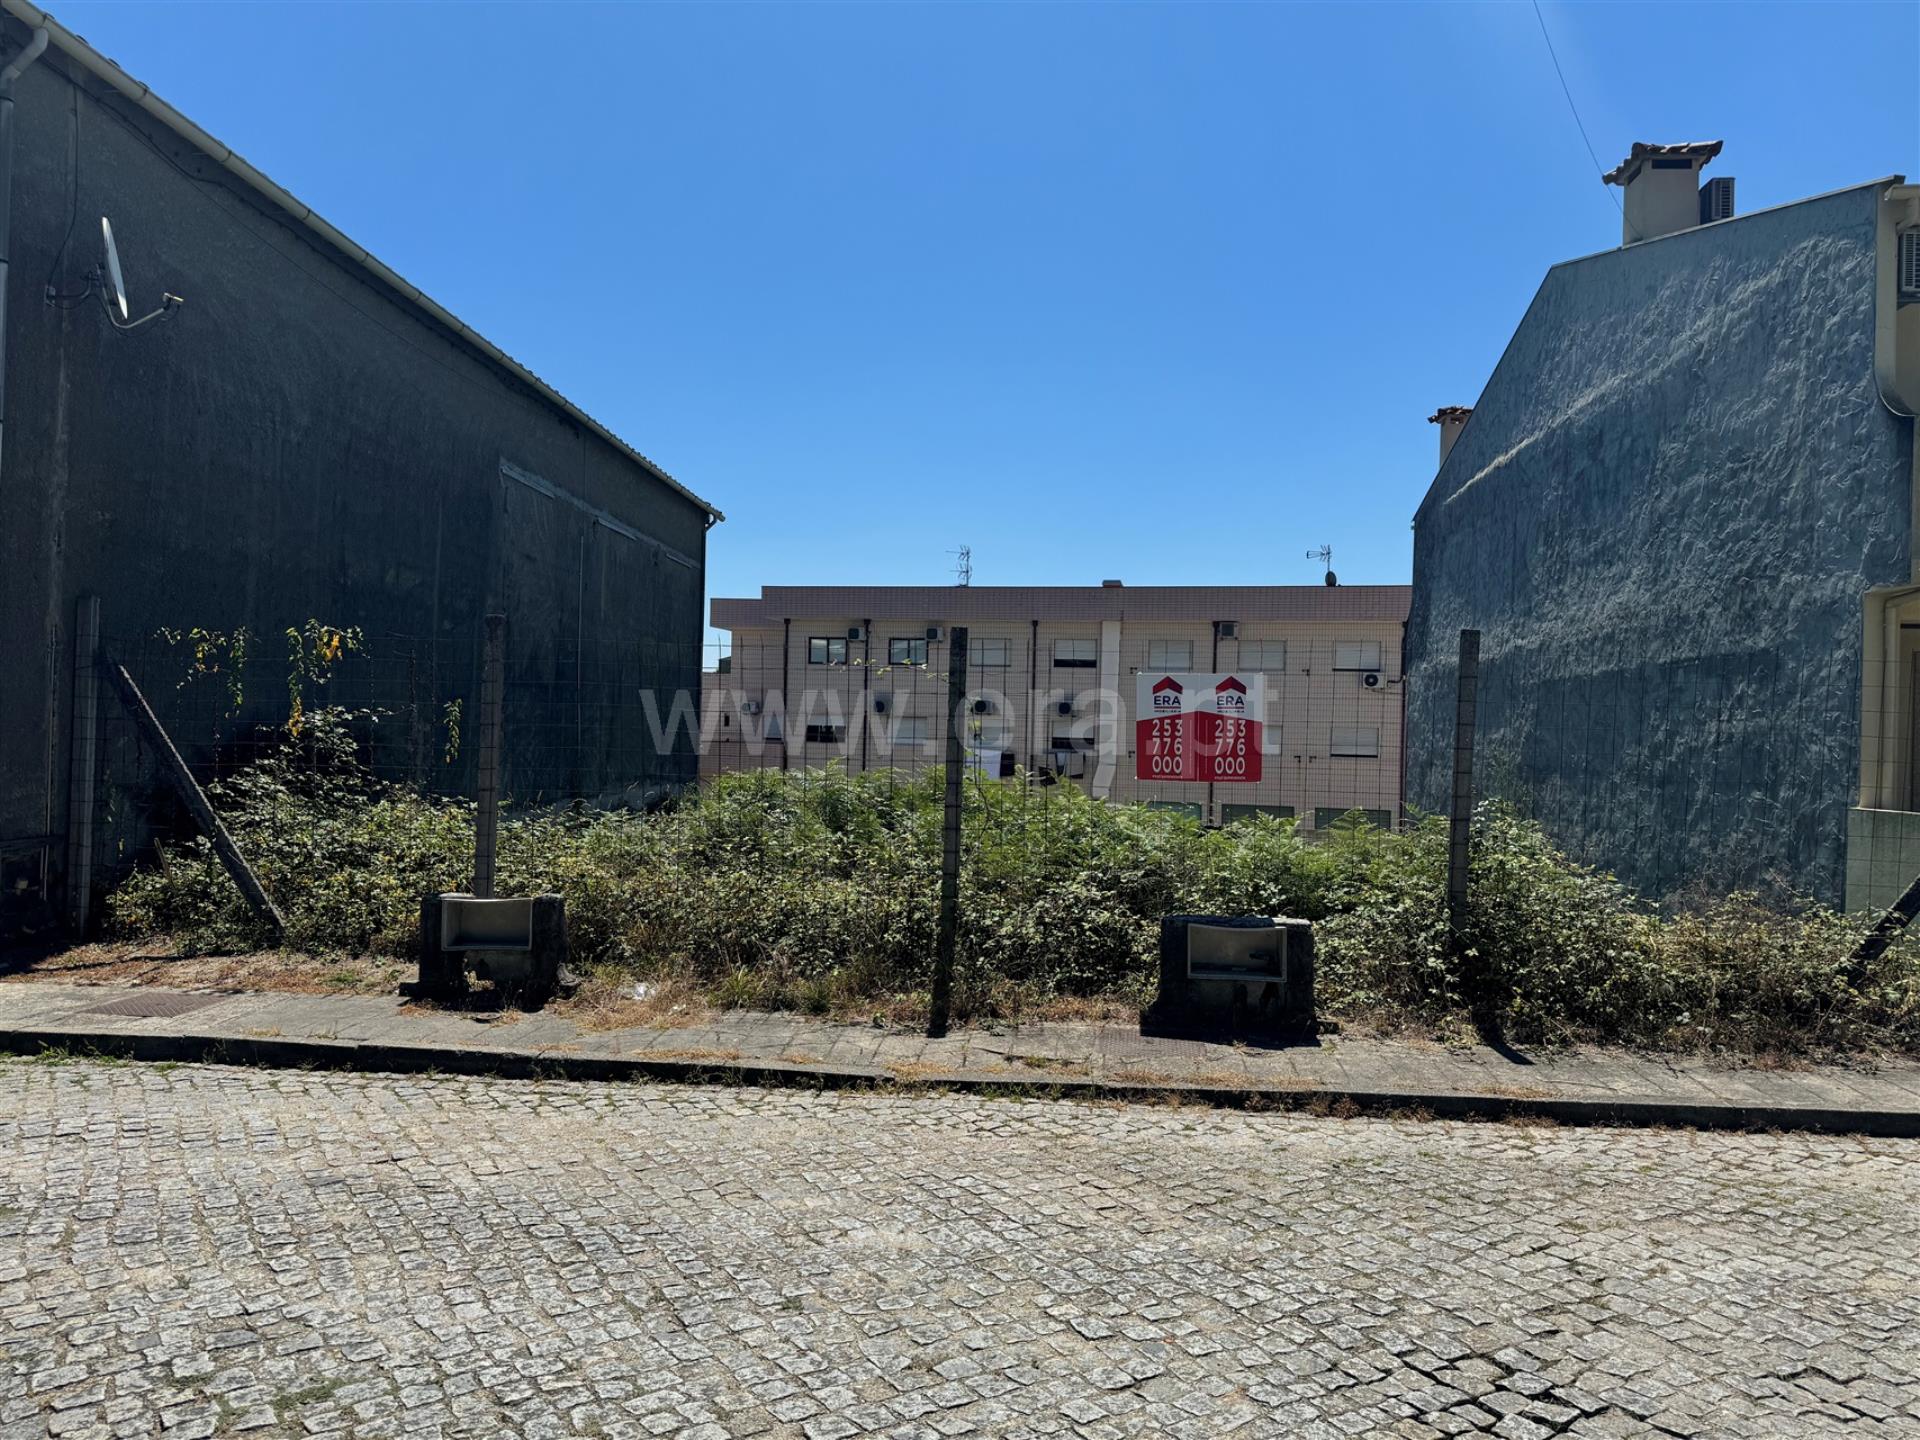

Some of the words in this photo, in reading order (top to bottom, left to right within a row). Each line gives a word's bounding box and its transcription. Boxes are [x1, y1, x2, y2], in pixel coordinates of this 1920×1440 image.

[1154, 695, 1181, 706] ERA
[1217, 695, 1245, 706] ERA
[1152, 719, 1183, 736] 253
[1215, 719, 1246, 737] 253
[1152, 738, 1183, 755] 776
[1215, 738, 1246, 756] 776
[1152, 756, 1183, 773] 000
[1214, 757, 1246, 774] 000
